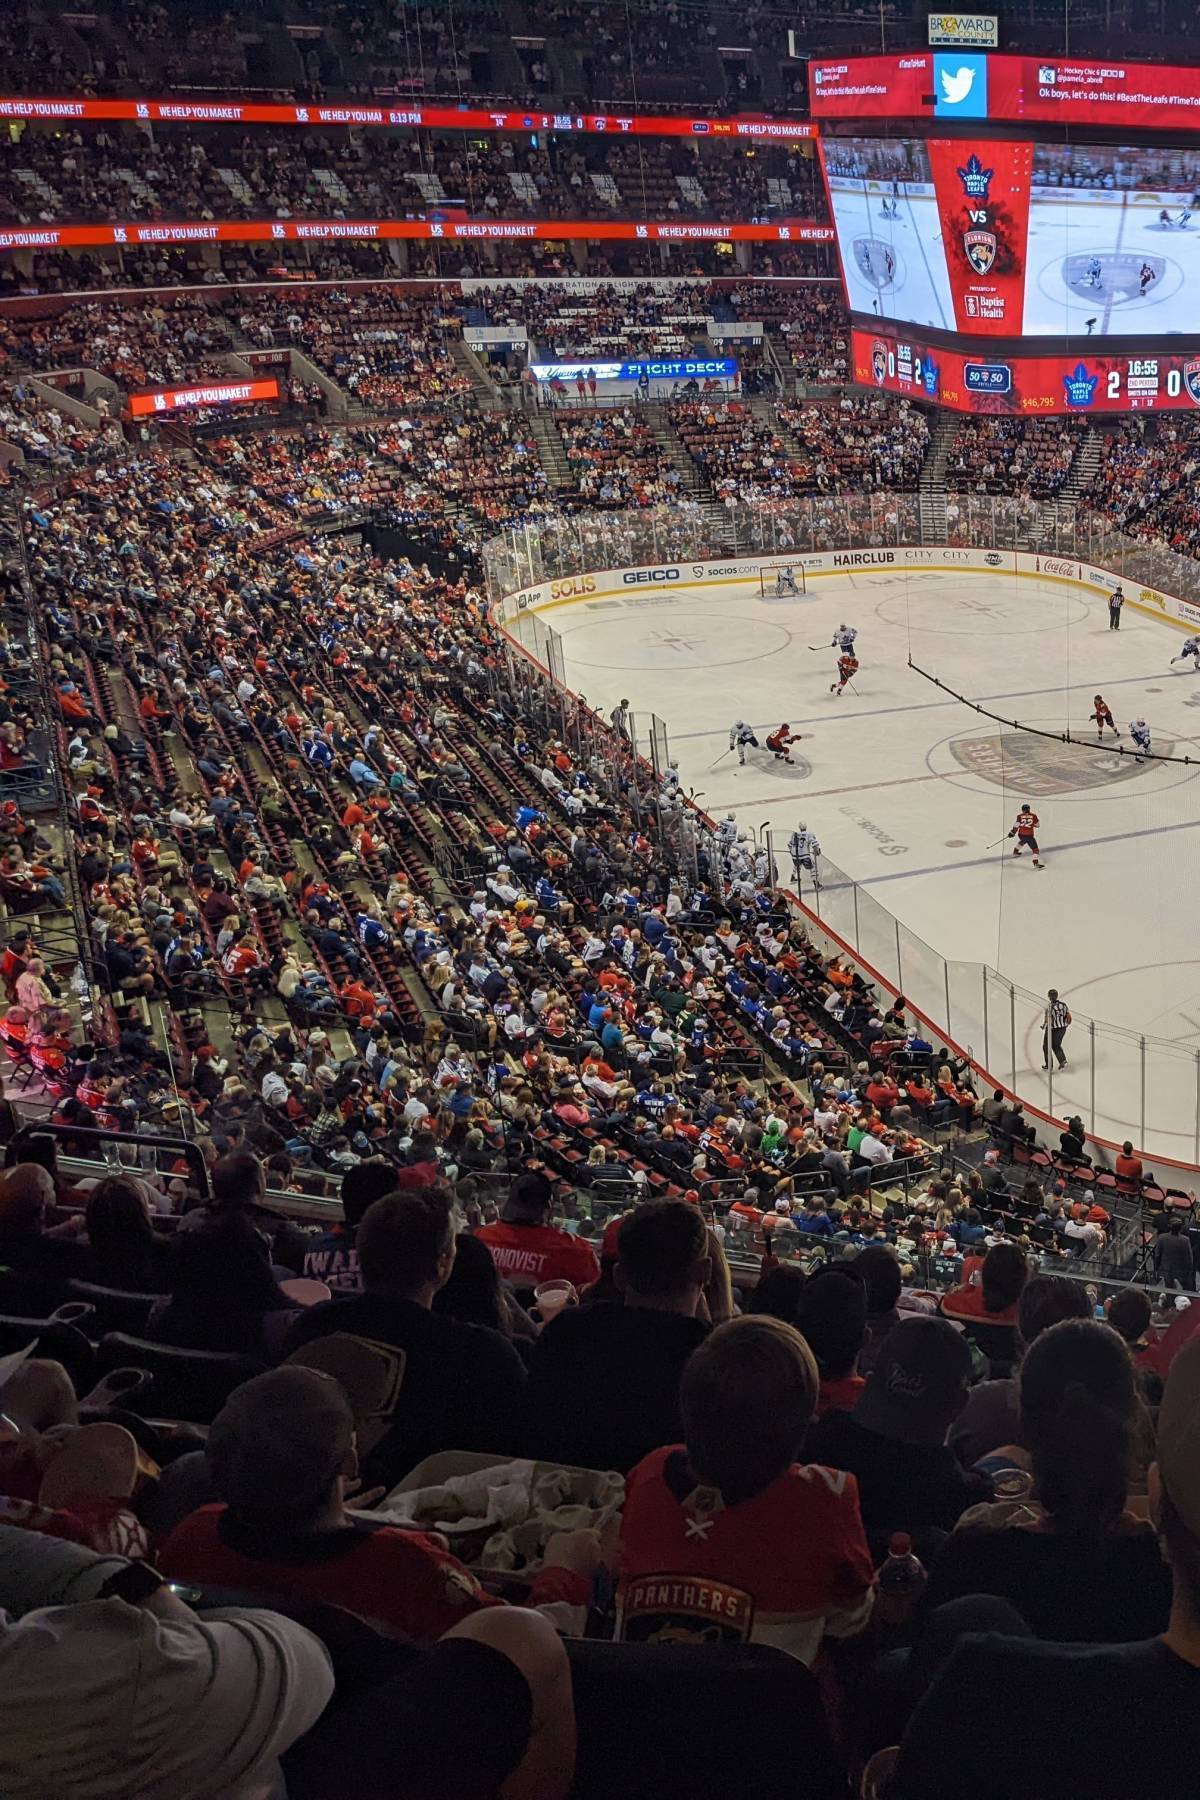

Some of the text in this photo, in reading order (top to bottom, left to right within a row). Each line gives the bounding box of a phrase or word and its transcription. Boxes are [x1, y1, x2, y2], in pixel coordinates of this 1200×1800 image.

[1039, 88, 1050, 98] Ok
[1051, 89, 1071, 100] boys,
[1072, 90, 1087, 100] let's
[1088, 92, 1098, 100] do
[1116, 94, 1168, 104] #BeatTheLeafs
[0, 104, 12, 113] WE
[13, 104, 32, 114] HELP
[34, 104, 50, 114] YOU
[52, 104, 74, 114] MAKE
[159, 107, 171, 117] WE
[172, 107, 190, 117] HELP
[192, 108, 208, 117] YOU
[210, 108, 232, 118] MAKE
[390, 114, 421, 123] 8:13 PM
[542, 118, 548, 127] 2
[738, 125, 748, 133] WE
[750, 125, 766, 134] HELP
[768, 126, 781, 134] YOU
[782, 126, 801, 135] MAKE
[964, 174, 988, 183] TORONTO
[969, 210, 986, 223] VS
[138, 230, 150, 240] WE
[151, 229, 170, 239] HELP
[171, 229, 187, 239] YOU
[187, 229, 208, 239] MAKE
[297, 227, 309, 236] WE
[310, 226, 329, 236] HELP
[330, 226, 346, 235] YOU
[348, 226, 368, 235] MAKE
[455, 226, 466, 235] WE
[468, 226, 487, 235] HELP
[488, 226, 504, 235] YOU
[505, 226, 525, 235] MAKE
[980, 296, 1004, 308] Baptist
[981, 308, 1003, 318] Health
[686, 363, 725, 373] DECK
[888, 352, 894, 378] 0
[1128, 361, 1157, 375] 16:55
[915, 358, 921, 384] 2
[970, 372, 979, 382] 50
[991, 373, 1003, 382] 50
[1069, 382, 1092, 390] TORONTO
[1107, 372, 1120, 398] 2
[1168, 370, 1180, 397] 0
[1023, 398, 1055, 408] $46,795
[834, 552, 894, 566] HAIRCLUB
[708, 565, 759, 576] socios.com
[623, 569, 679, 584] GEICO
[551, 577, 595, 600] SOLIS
[634, 1585, 738, 1618] PANTHERS
